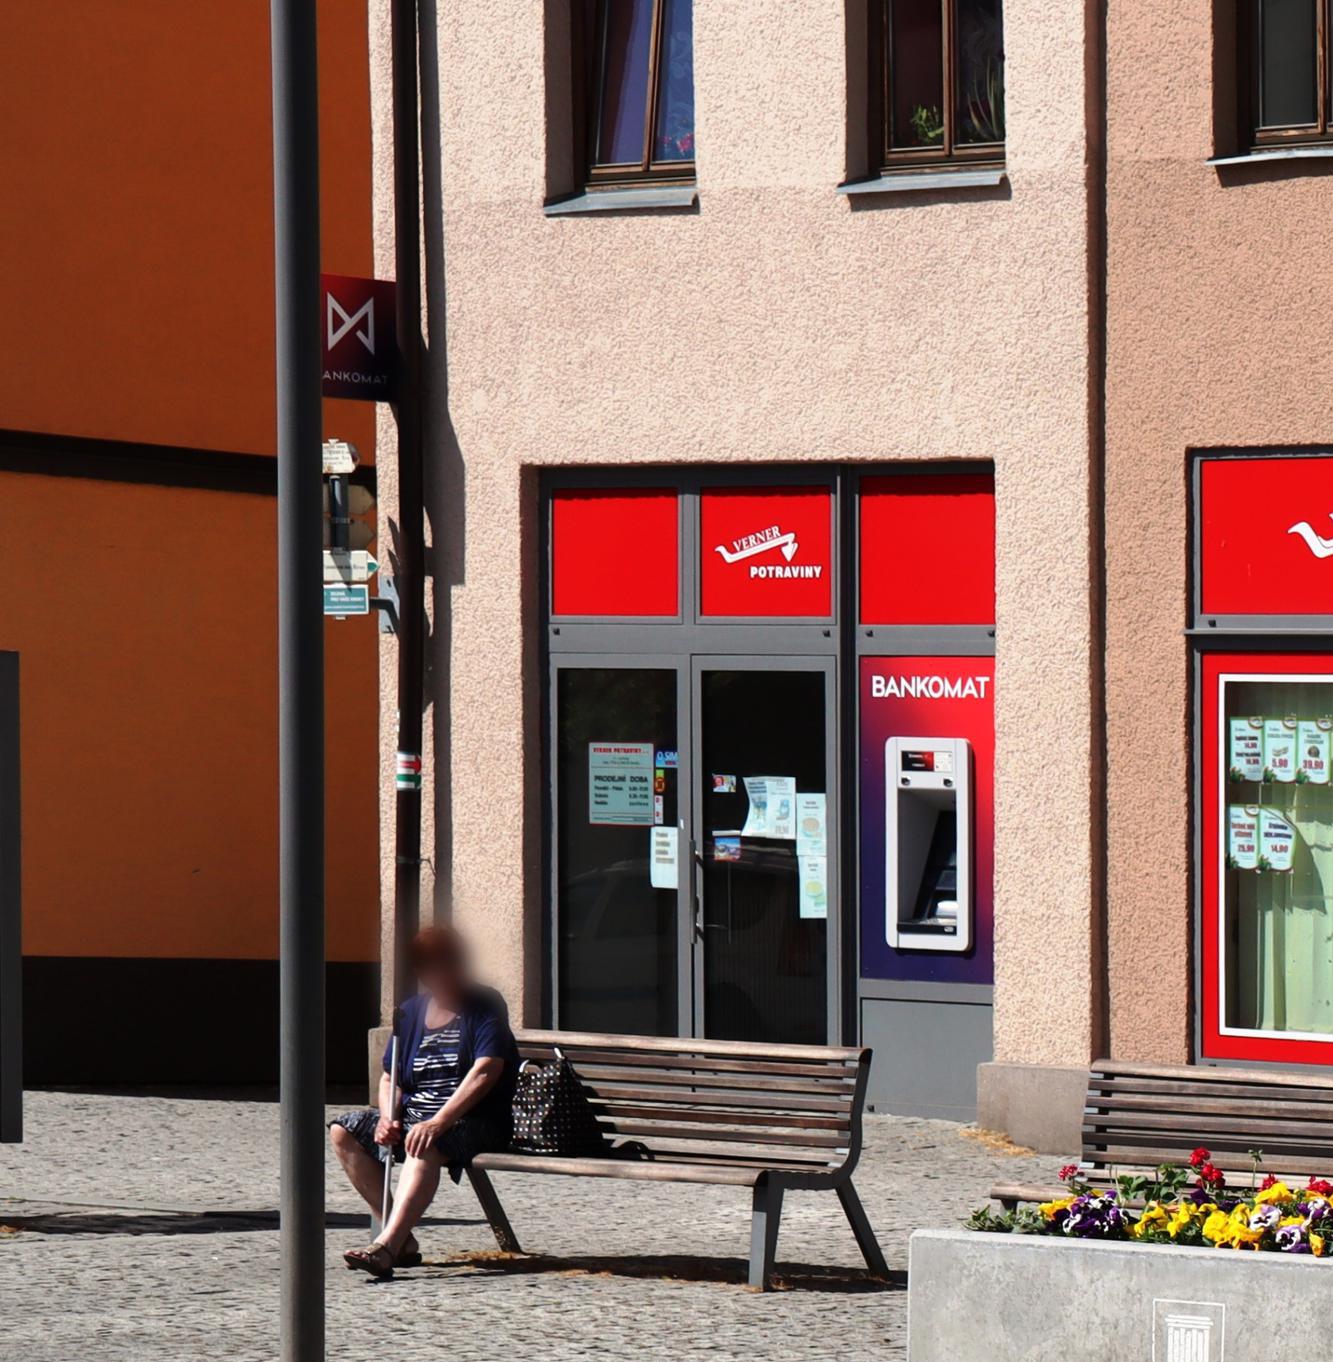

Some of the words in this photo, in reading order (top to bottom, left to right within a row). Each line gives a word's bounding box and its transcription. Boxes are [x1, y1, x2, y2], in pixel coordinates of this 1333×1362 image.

[322, 370, 388, 385] ANKOMAT
[733, 525, 781, 552] VERNER
[750, 566, 822, 579] POTRAVINY
[871, 675, 990, 698] BANKOMAT
